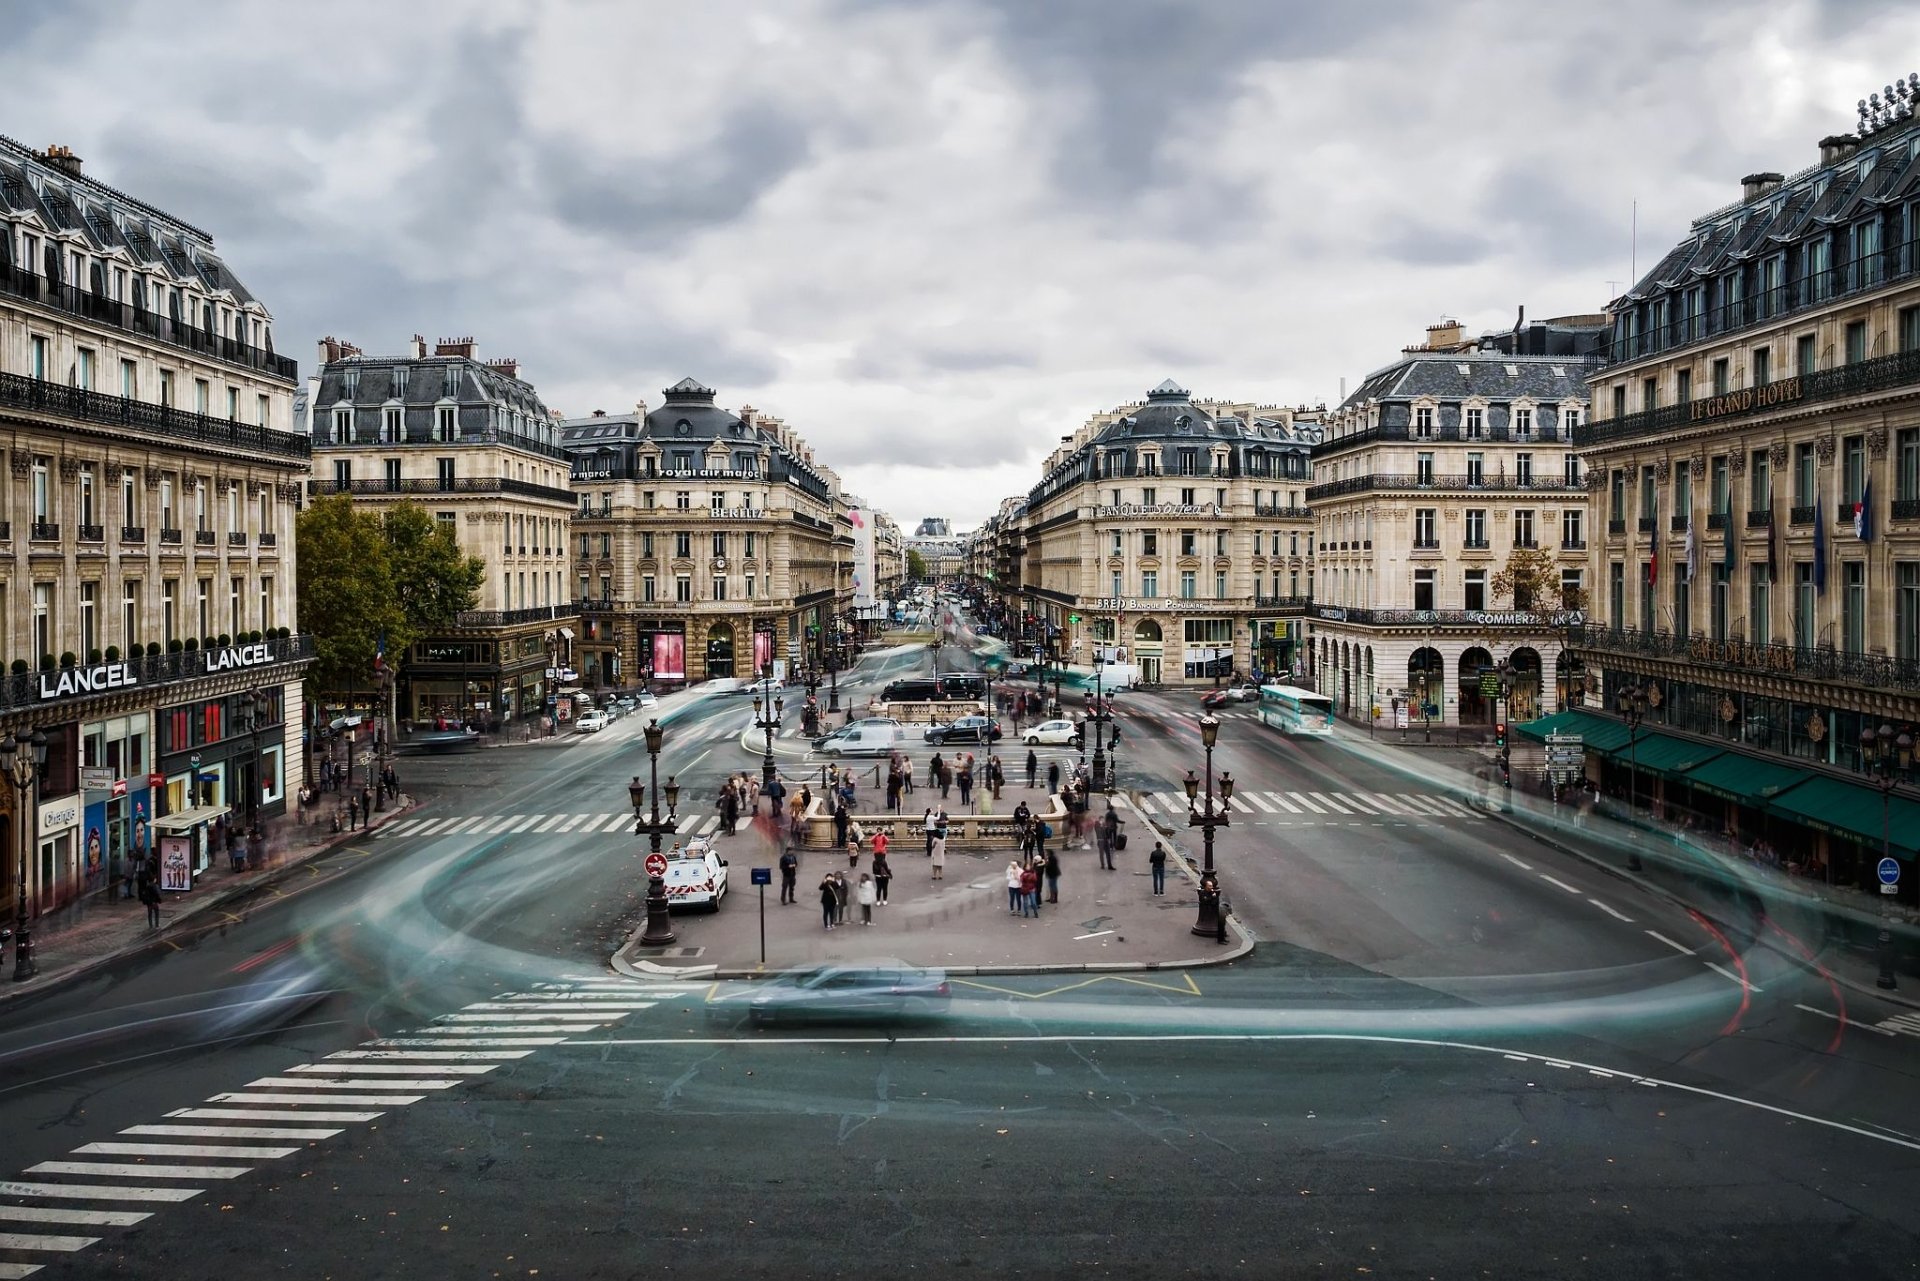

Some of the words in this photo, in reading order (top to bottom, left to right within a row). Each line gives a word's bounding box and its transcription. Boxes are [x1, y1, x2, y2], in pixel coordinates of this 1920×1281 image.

[1691, 401, 1703, 420] LE
[1707, 391, 1752, 417] GRAND
[578, 470, 611, 479] maroc
[659, 468, 696, 478] royal
[700, 469, 720, 477] air
[723, 470, 759, 478] maroc
[1101, 505, 1148, 516] BANQUE
[1097, 598, 1127, 609] BRED
[1478, 614, 1566, 626] COMMERZNK
[206, 644, 274, 672] LANCEL
[1725, 641, 1741, 663] DE
[1744, 645, 1760, 666] LA
[40, 663, 137, 699] LANCEL
[88, 780, 106, 788] Change
[44, 808, 76, 828] Change
